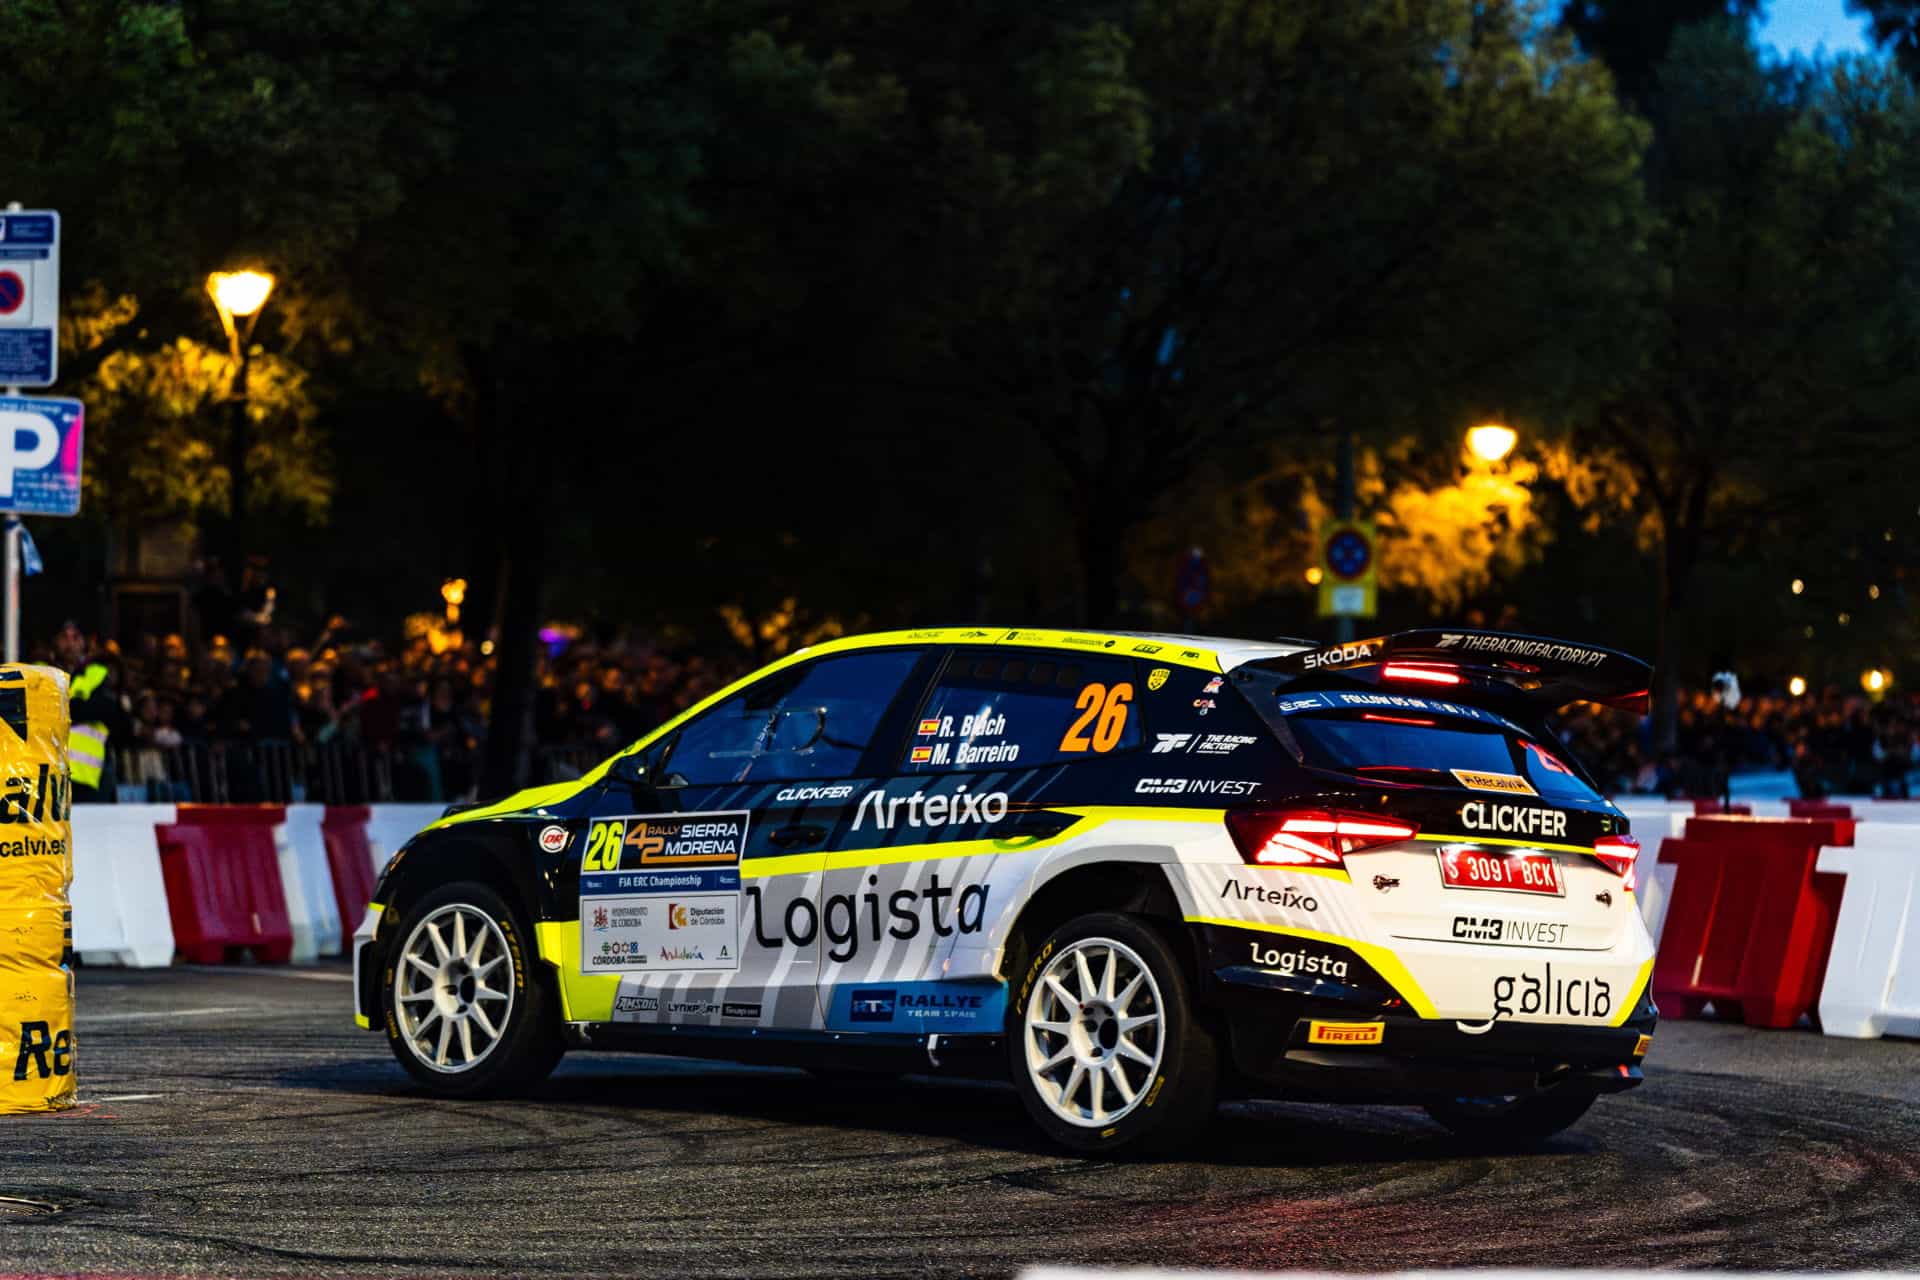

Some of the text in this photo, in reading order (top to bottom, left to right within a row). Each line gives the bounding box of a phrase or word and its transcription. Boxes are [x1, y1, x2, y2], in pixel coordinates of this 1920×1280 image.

[0, 411, 60, 497] P
[1462, 634, 1608, 667] THERACINGFACTORY.PT
[939, 715, 955, 738] R.
[1058, 681, 1134, 754] 26
[1199, 742, 1240, 751] FACTORY
[1206, 734, 1258, 745] THE RACING
[931, 740, 1020, 766] M. Barreiro
[776, 784, 854, 802] CLICKFER
[1187, 779, 1263, 796] INVEST
[851, 783, 1009, 832] Arteixo
[1461, 802, 1568, 838] CLICKFER
[583, 822, 624, 871] 26
[647, 826, 680, 837] RALLY
[681, 823, 739, 838] SIERRA
[665, 839, 736, 856] MORENA
[618, 873, 702, 888] FIA ERC Championship
[1446, 854, 1555, 887] S 3091 BCK
[1221, 879, 1318, 912] Arteixo
[746, 873, 991, 963] logista
[1505, 921, 1568, 943] INVEST
[1250, 942, 1348, 978] logista
[617, 997, 658, 1012] AMSOIL
[900, 993, 984, 1010] RALLYE
[906, 1009, 977, 1019] TEAM SPAIN
[1316, 1026, 1378, 1041] PIRELLI
[13, 1020, 71, 1082] Re
